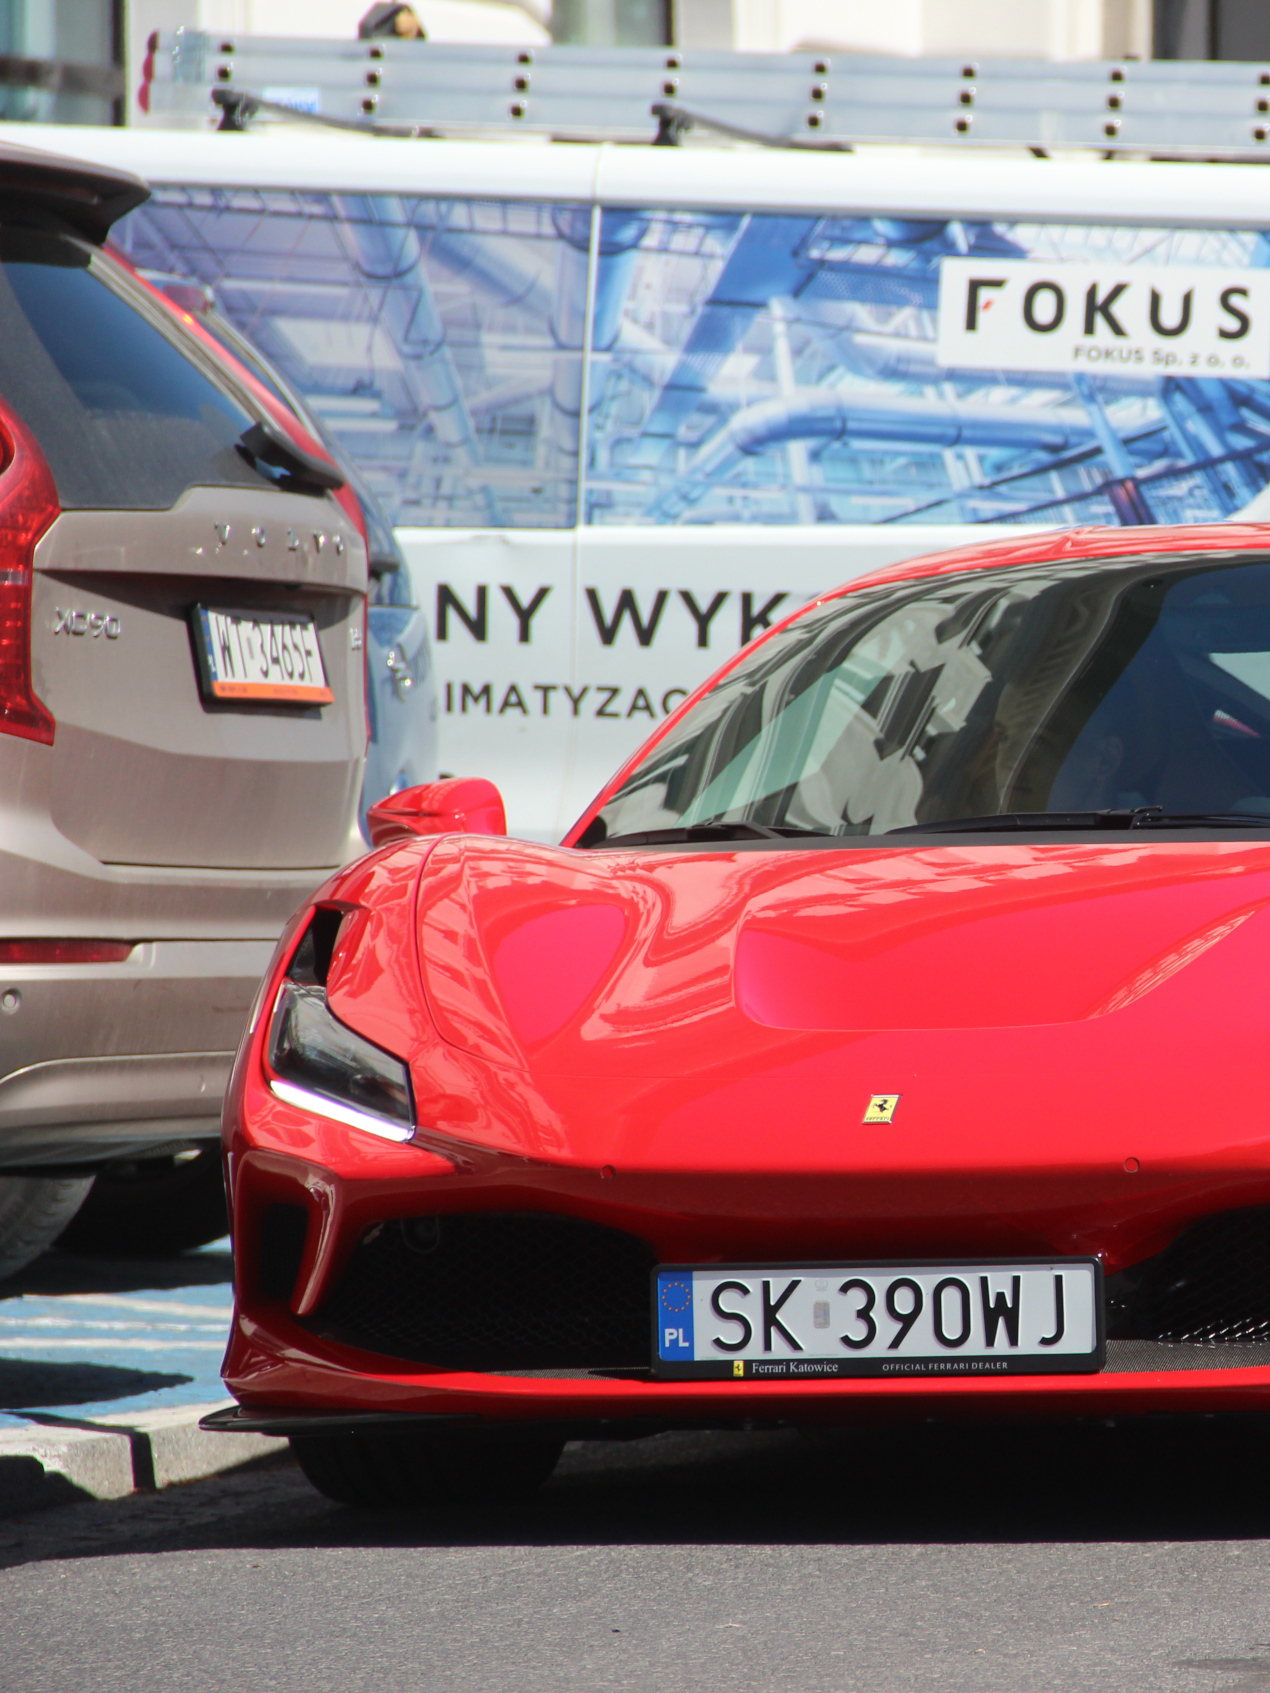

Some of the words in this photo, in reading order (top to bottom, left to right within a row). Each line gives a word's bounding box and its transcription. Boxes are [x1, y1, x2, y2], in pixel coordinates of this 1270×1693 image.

[966, 278, 1250, 340] FOKUS
[1074, 346, 1144, 363] FOKUS
[1152, 349, 1182, 367] Sp.
[1189, 354, 1200, 366] z
[214, 522, 344, 554] VOLVO
[54, 606, 121, 638] XC90
[436, 583, 552, 643] NY
[215, 614, 246, 679] WT
[711, 1278, 804, 1352] SK
[839, 1274, 1065, 1350] 390WJ
[664, 1328, 690, 1348] PL
[752, 1362, 786, 1373] Ferrari
[789, 1361, 838, 1373] Katowice
[882, 1363, 926, 1372] OFFICIAL
[928, 1363, 968, 1371] FERRARI
[971, 1361, 1008, 1370] DEALER
